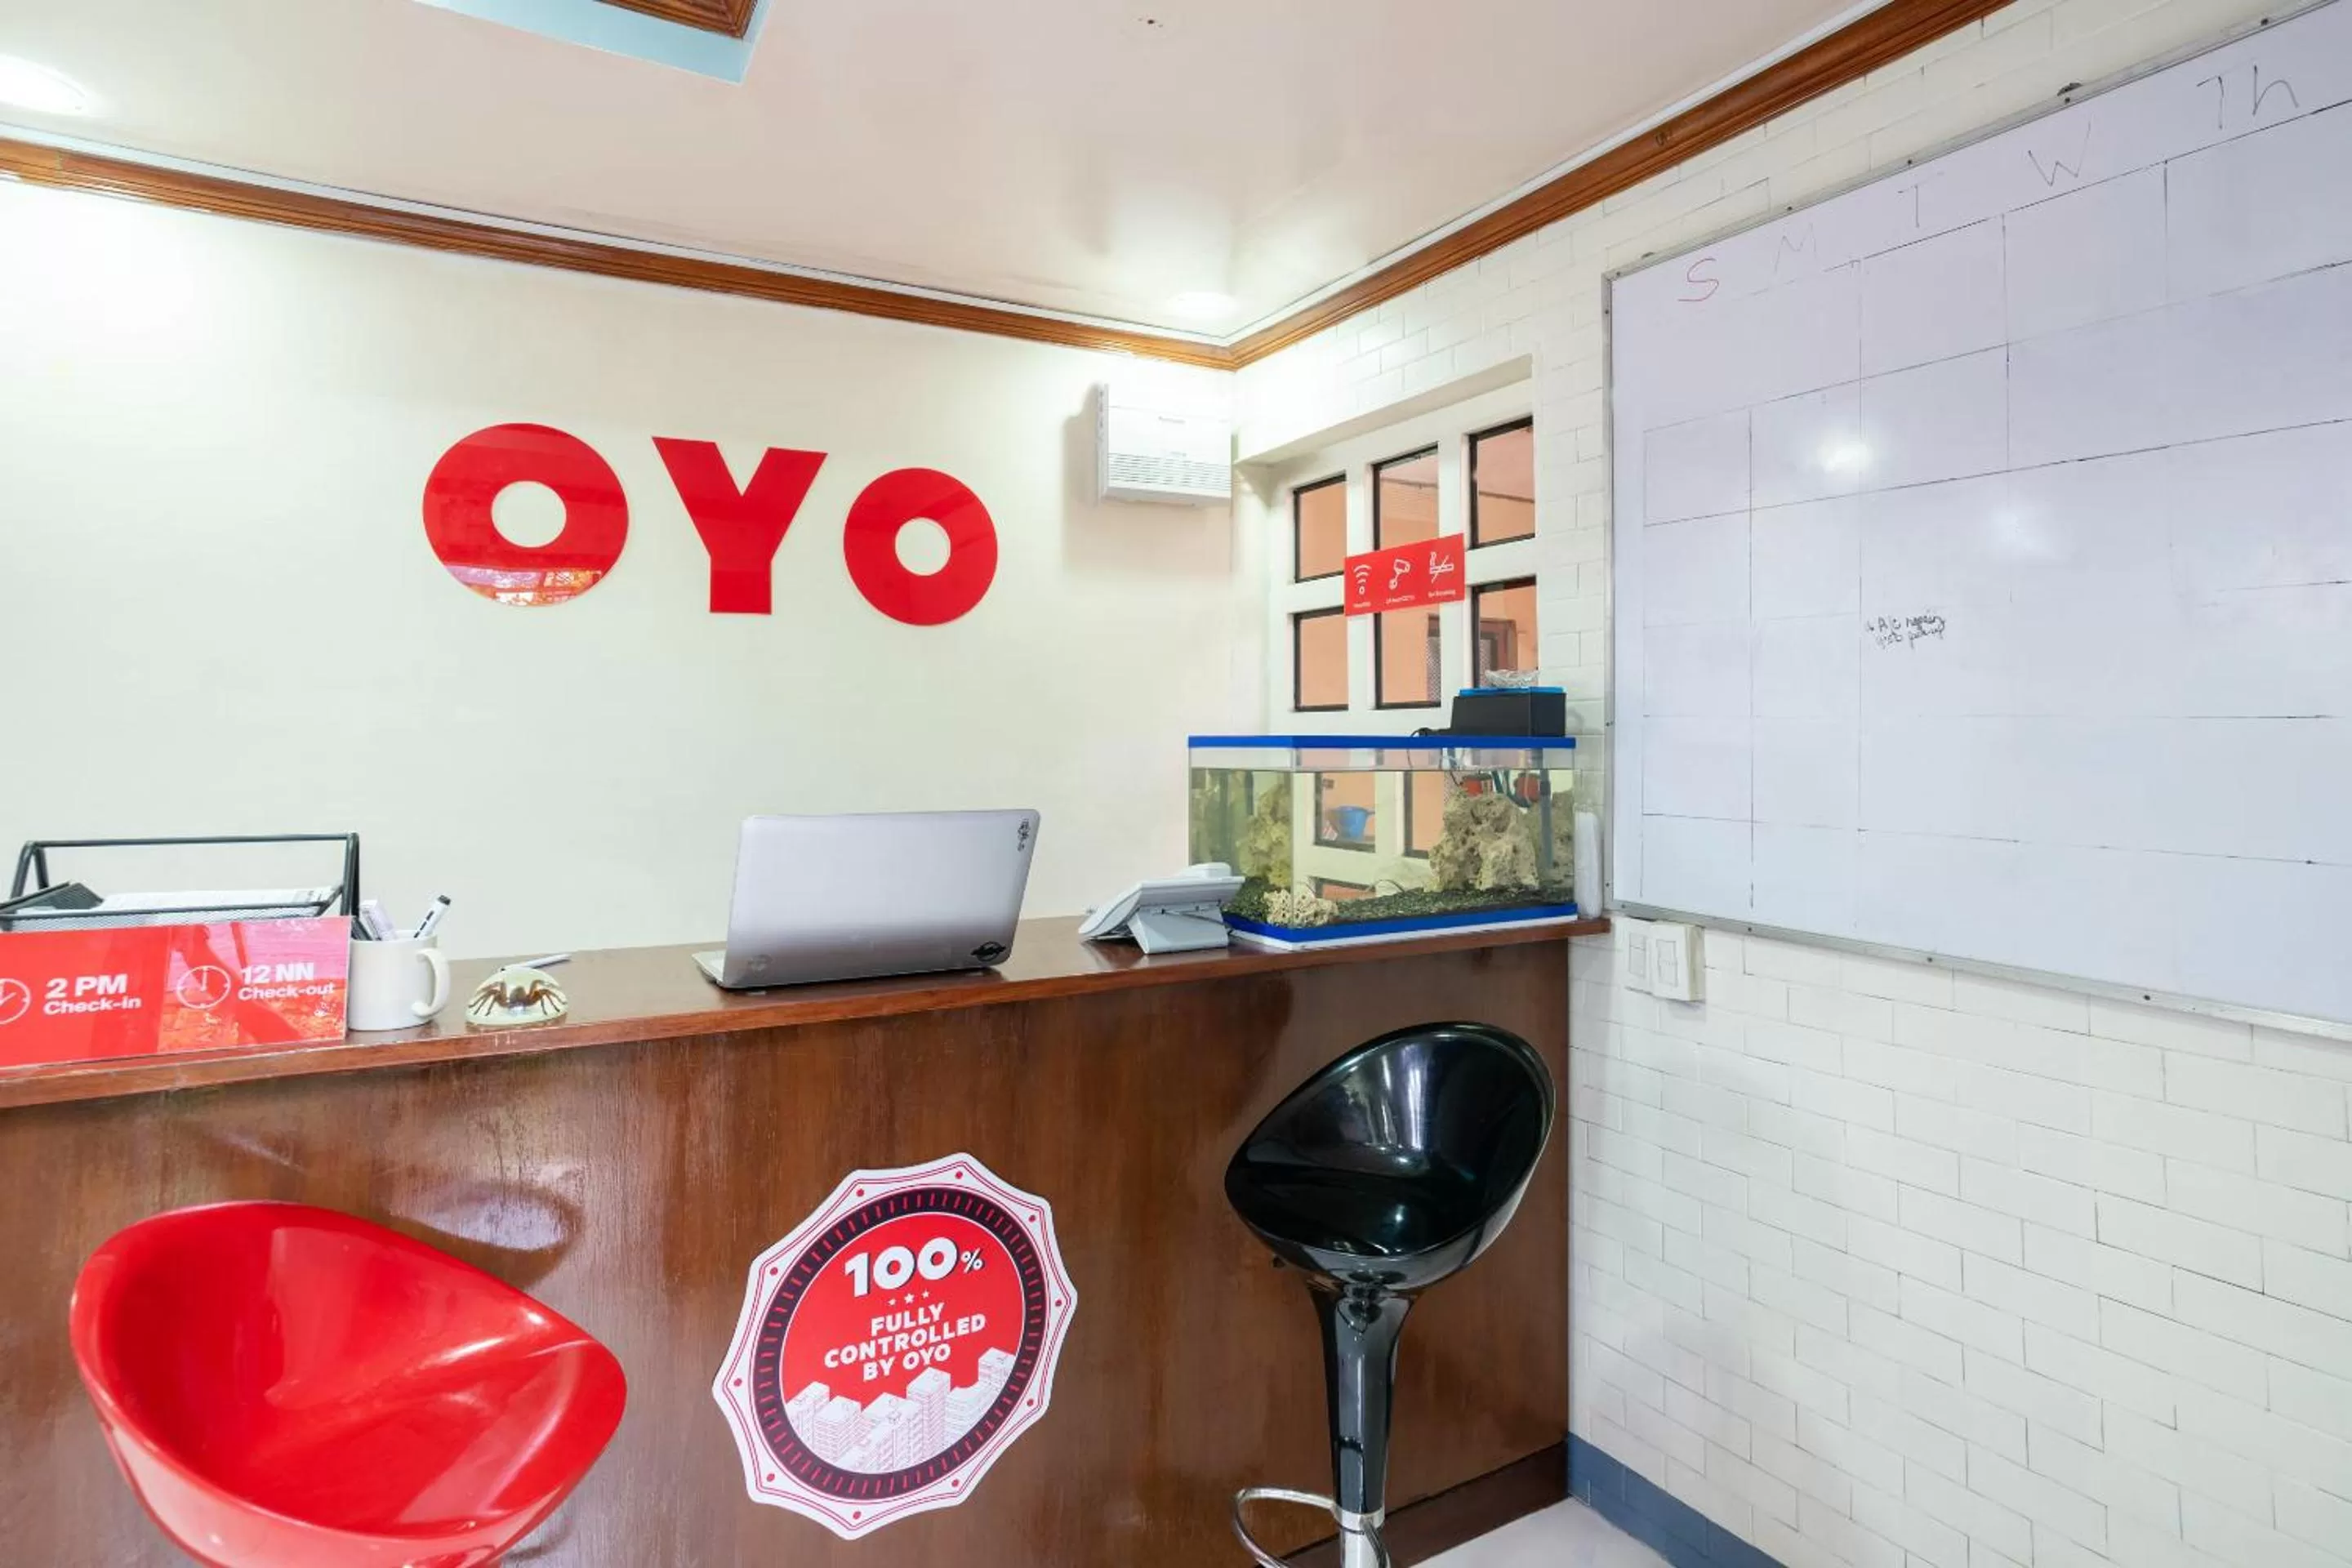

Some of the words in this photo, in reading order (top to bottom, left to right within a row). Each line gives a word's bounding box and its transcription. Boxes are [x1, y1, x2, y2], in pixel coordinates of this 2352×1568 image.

[1677, 256, 1719, 301] S
[2028, 113, 2094, 187] W
[2197, 63, 2299, 129] Th
[421, 421, 999, 626] OYO
[45, 977, 68, 1000] 2
[75, 973, 128, 996] PM
[238, 982, 336, 1002] Check-out
[241, 964, 270, 985] 12
[275, 962, 314, 982] NN
[43, 996, 142, 1016] Check-in
[844, 1236, 986, 1298] 100%
[870, 1302, 945, 1337] FULLY
[823, 1312, 987, 1369] CONTROLLED
[862, 1356, 896, 1382] BY
[902, 1343, 951, 1370] OYO
